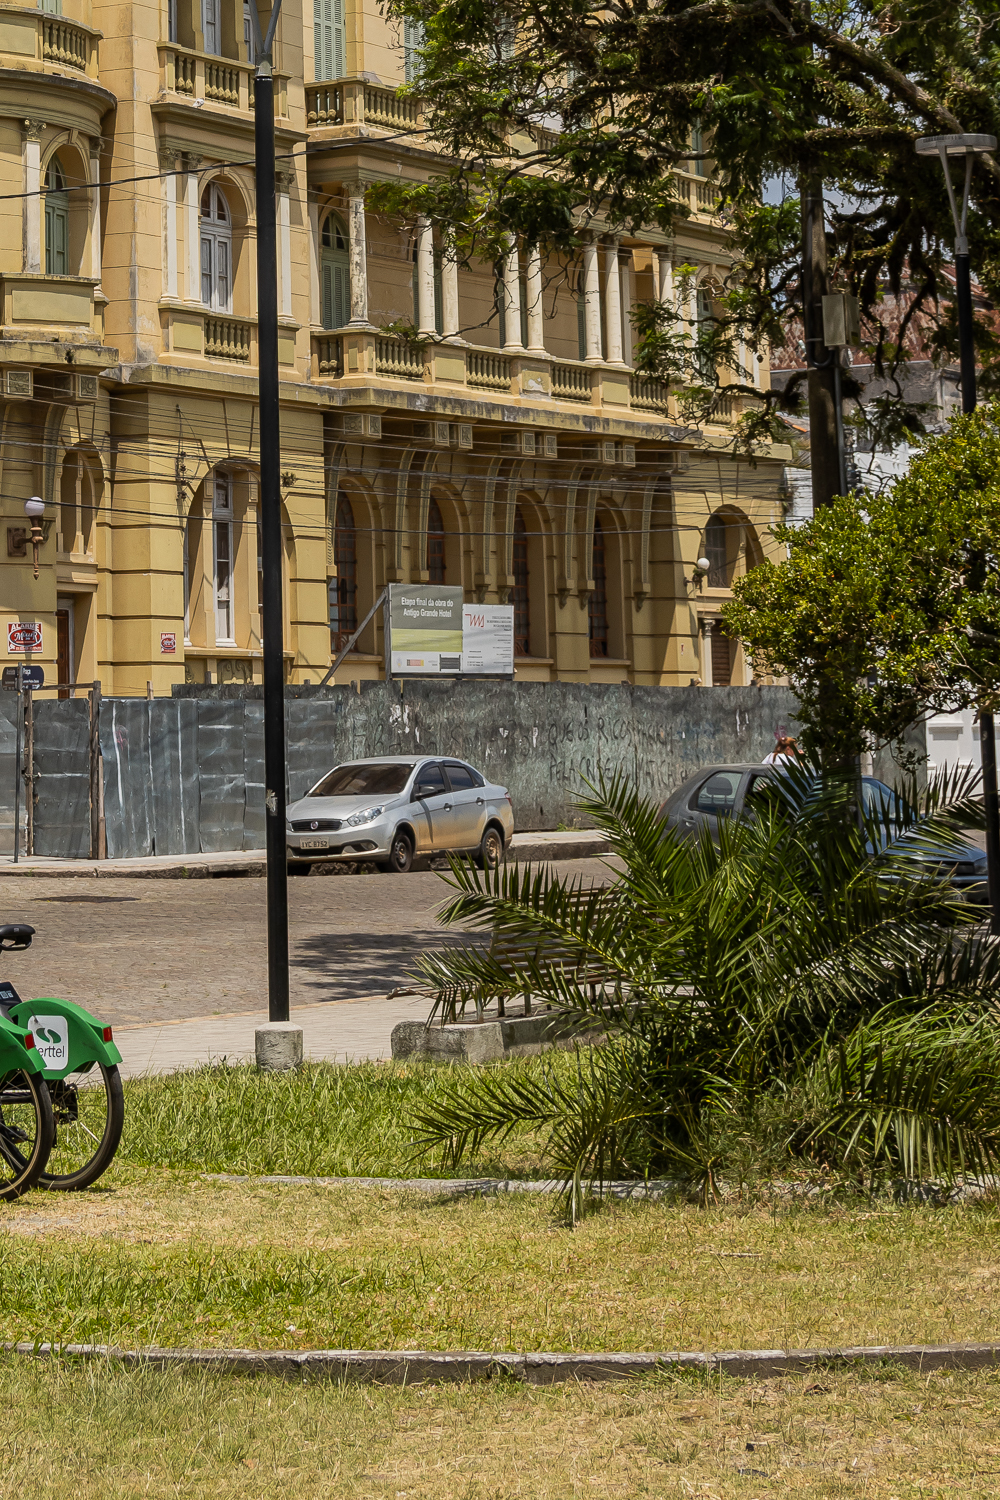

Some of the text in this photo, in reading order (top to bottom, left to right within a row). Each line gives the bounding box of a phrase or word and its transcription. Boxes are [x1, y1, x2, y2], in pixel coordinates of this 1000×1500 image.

[401, 597, 453, 607] Etapa final da obra do
[403, 608, 452, 618] Antigo Grande Hotel
[11, 623, 39, 631] ALARME
